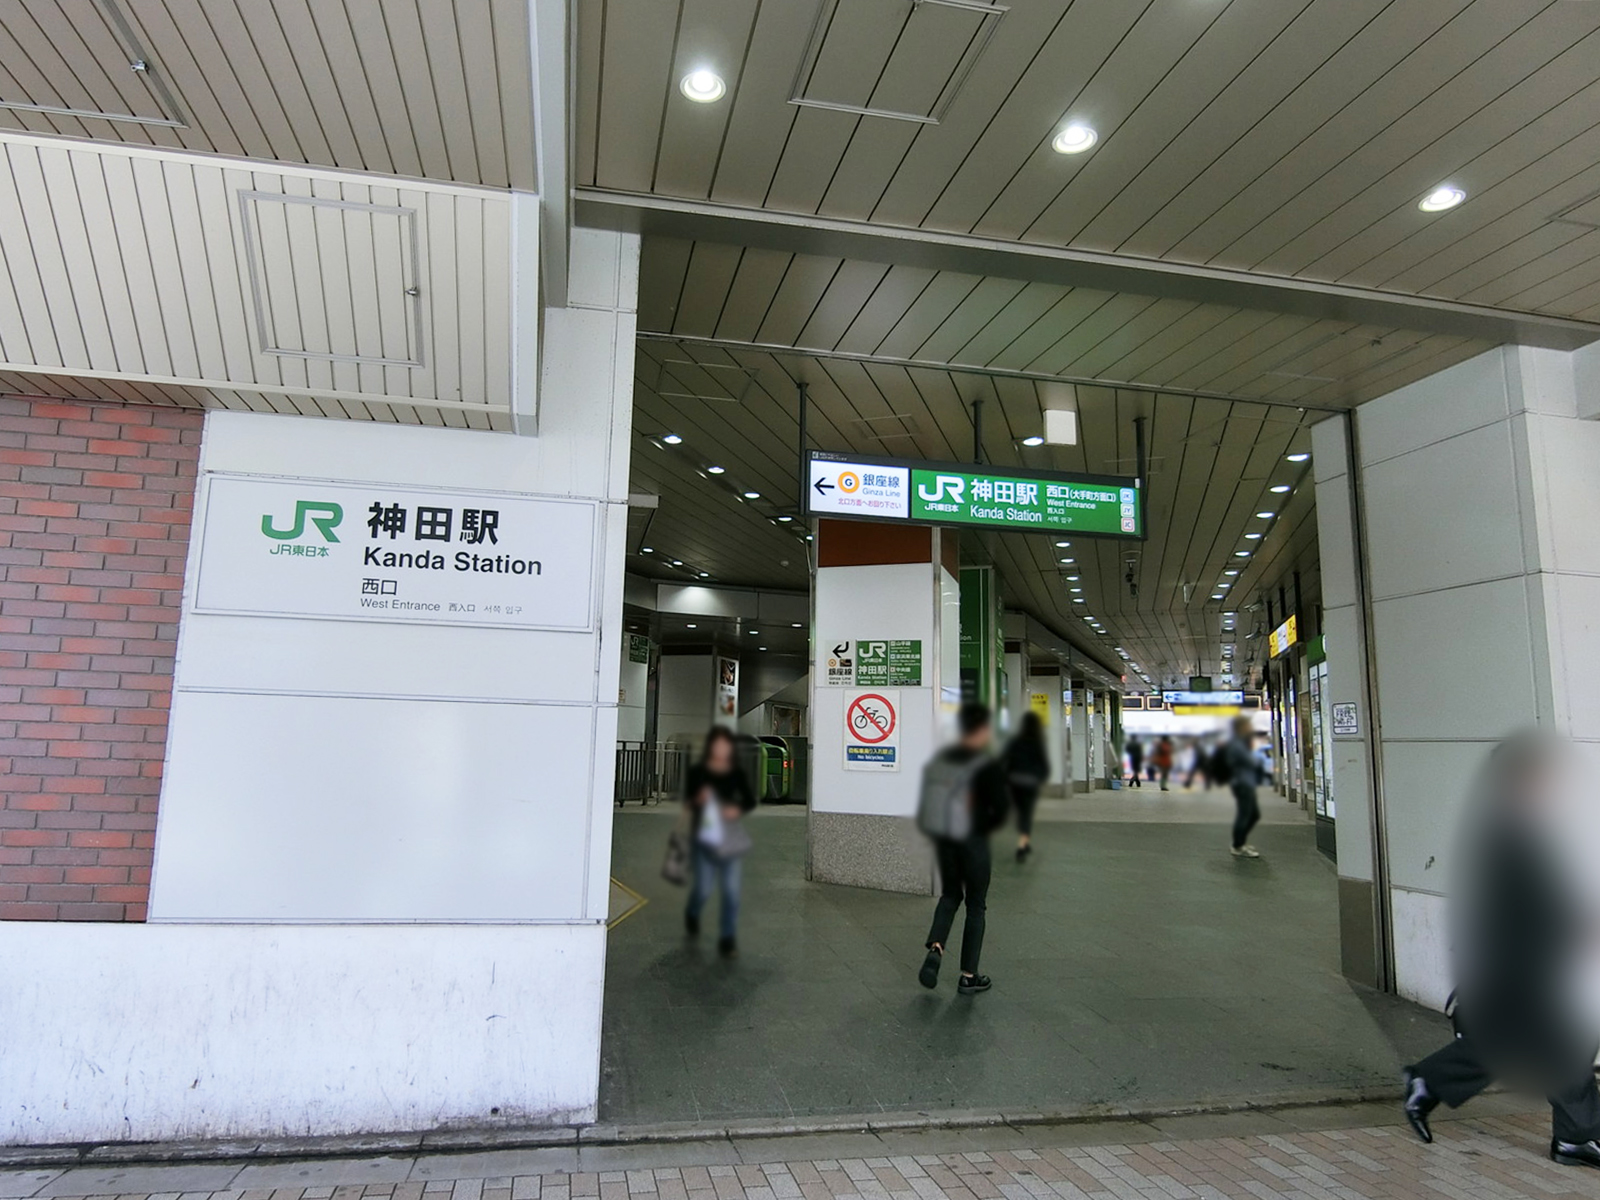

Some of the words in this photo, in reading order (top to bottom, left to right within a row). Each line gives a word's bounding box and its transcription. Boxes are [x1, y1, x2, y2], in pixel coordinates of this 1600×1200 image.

[844, 478, 853, 487] G
[862, 473, 900, 488] 銀座線
[862, 487, 884, 496] Ginza
[885, 489, 901, 497] Line
[918, 475, 965, 503] JR
[970, 478, 1038, 506] 神田駅
[924, 503, 959, 512] JR東日本
[1047, 499, 1064, 507] West
[1066, 500, 1096, 509] Entrance
[970, 505, 1004, 519] Kanda
[1006, 507, 1042, 522] Station
[261, 500, 343, 543] JR
[367, 501, 499, 545] 神田駅
[269, 544, 329, 557] JR東日本
[364, 546, 445, 570] Kanda
[454, 551, 542, 575] Station
[362, 578, 397, 595] 西口
[360, 598, 388, 609] West
[392, 599, 441, 611] Entrance
[448, 602, 476, 613] 西入口
[859, 642, 886, 658] JR
[858, 665, 887, 674] 神田駅
